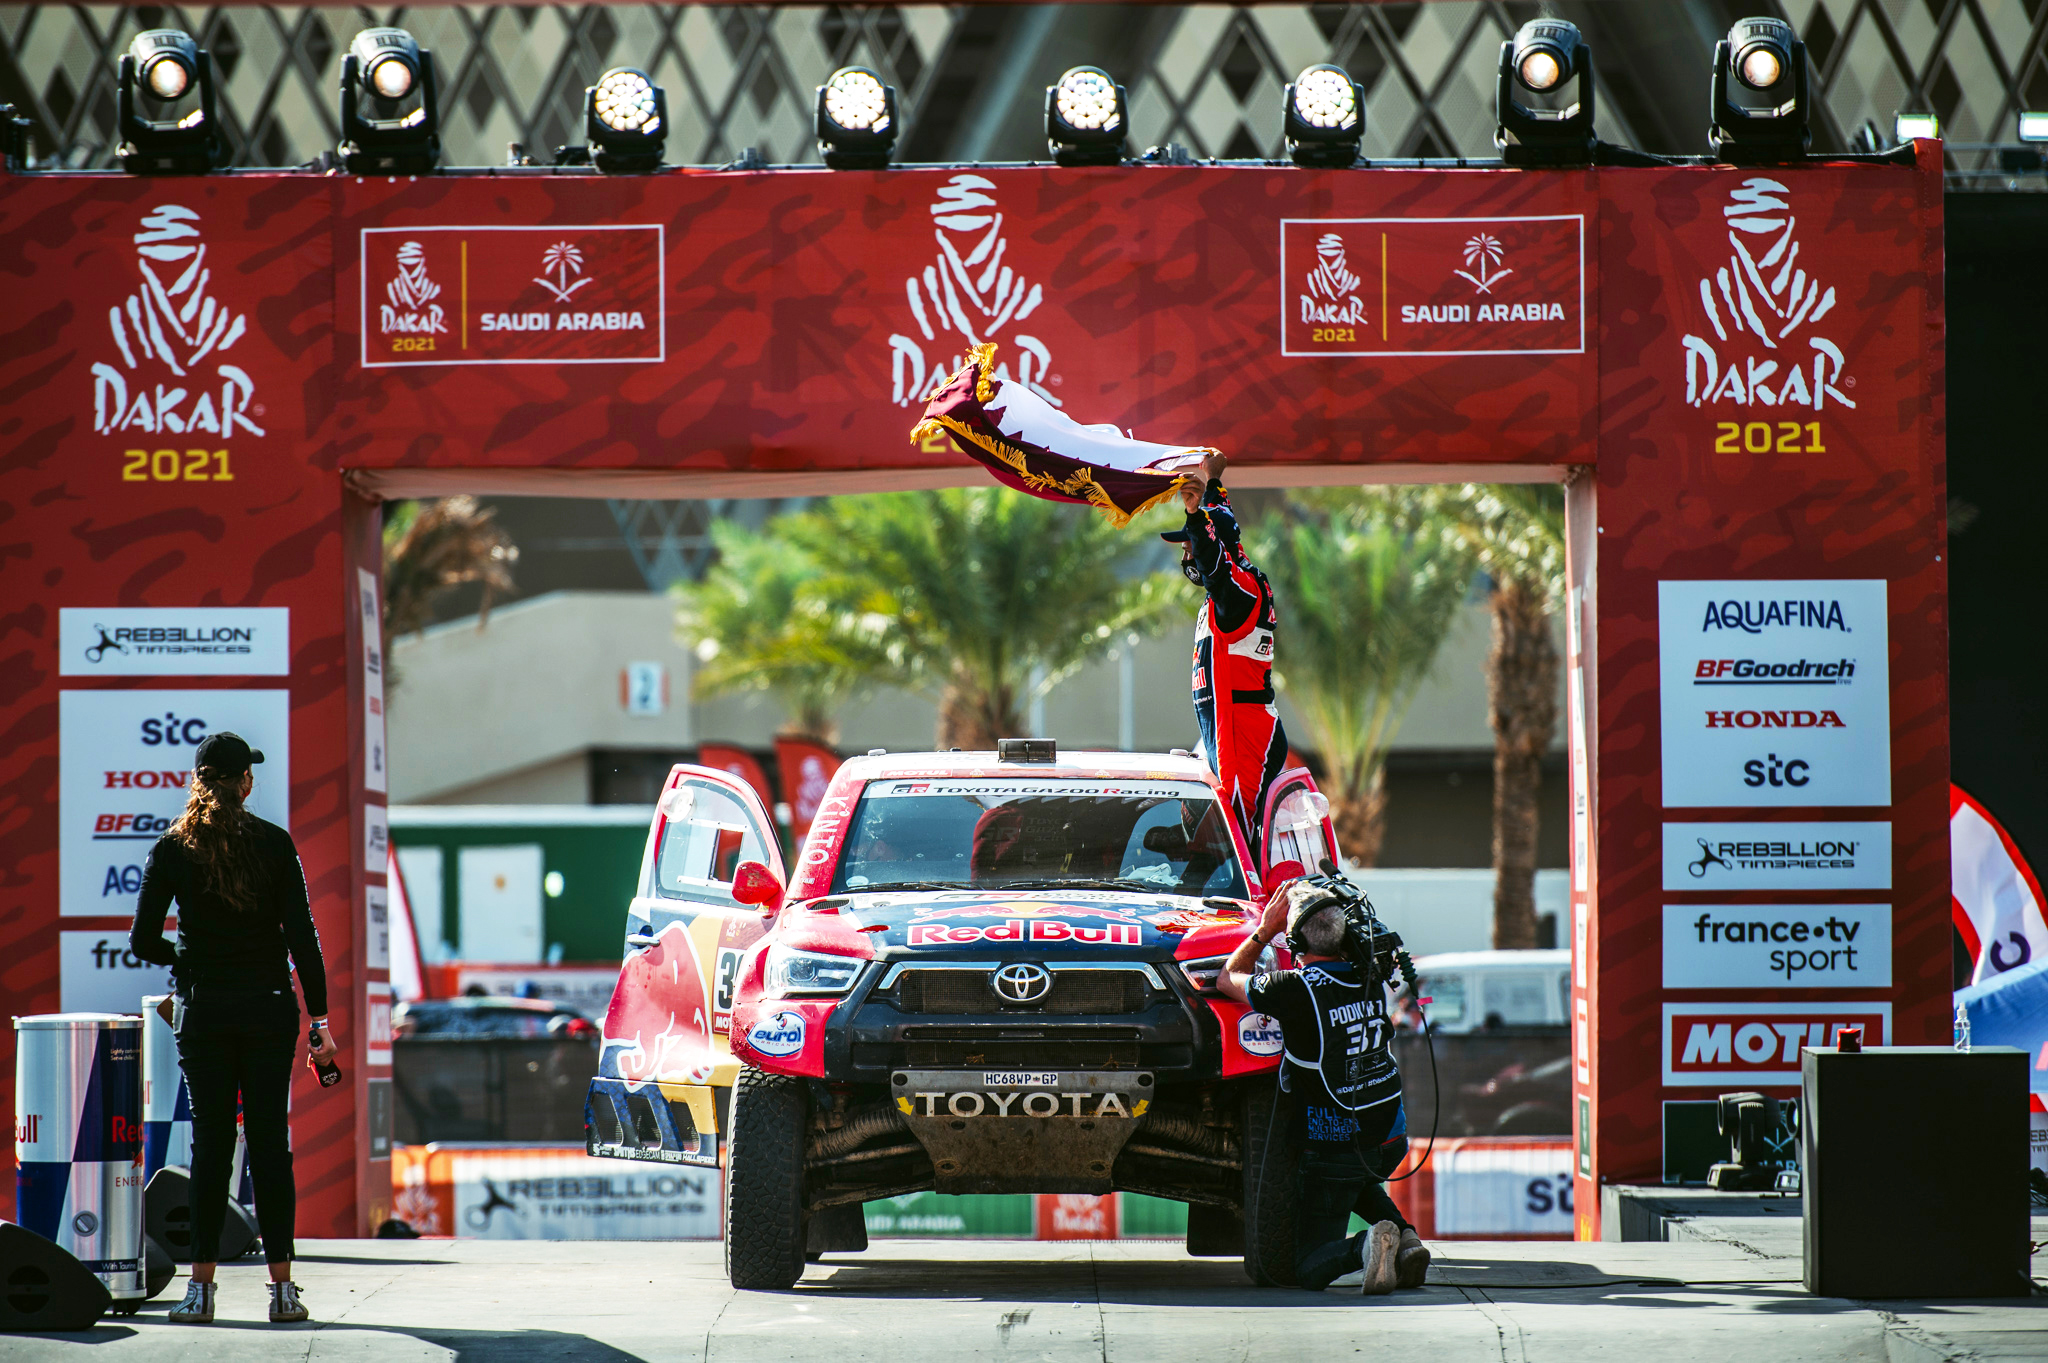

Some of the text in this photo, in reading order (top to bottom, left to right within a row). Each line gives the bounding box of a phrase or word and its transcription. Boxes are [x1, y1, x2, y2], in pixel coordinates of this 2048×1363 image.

[379, 303, 449, 334] DAKAR
[1300, 294, 1369, 326] DAKAR
[1401, 303, 1566, 323] SAUDI ARABIA
[480, 312, 646, 331] SAUDI ARABIA
[391, 338, 437, 352] 2021
[1312, 328, 1357, 342] 2021
[1682, 334, 1856, 411] DAKAR
[91, 362, 265, 438] DAKAR
[1715, 421, 1827, 453] 2021
[122, 450, 234, 481] 2021
[1702, 599, 1846, 633] AQUAFINA
[1695, 658, 1856, 678] BFGoodrich
[141, 712, 207, 746] stc
[1705, 710, 1847, 728] HONDA
[103, 770, 193, 789] HON
[886, 769, 948, 777] MOTUL
[1743, 753, 1811, 787] stc
[1103, 788, 1180, 798] Racing
[907, 920, 1142, 945] Red Bull
[1769, 945, 1858, 980] sport
[718, 951, 745, 1010] 3
[754, 1026, 802, 1043] eurol
[1242, 1030, 1283, 1042] euro
[1346, 1018, 1386, 1056] 37
[986, 1073, 1057, 1085] HC68WP GP
[915, 1092, 1130, 1118] TOYOTA
[1307, 1106, 1342, 1119] FULL
[1308, 1125, 1361, 1134] MULTIMEDA
[1308, 1132, 1351, 1141] SERVICES
[1526, 1172, 1575, 1215] st
